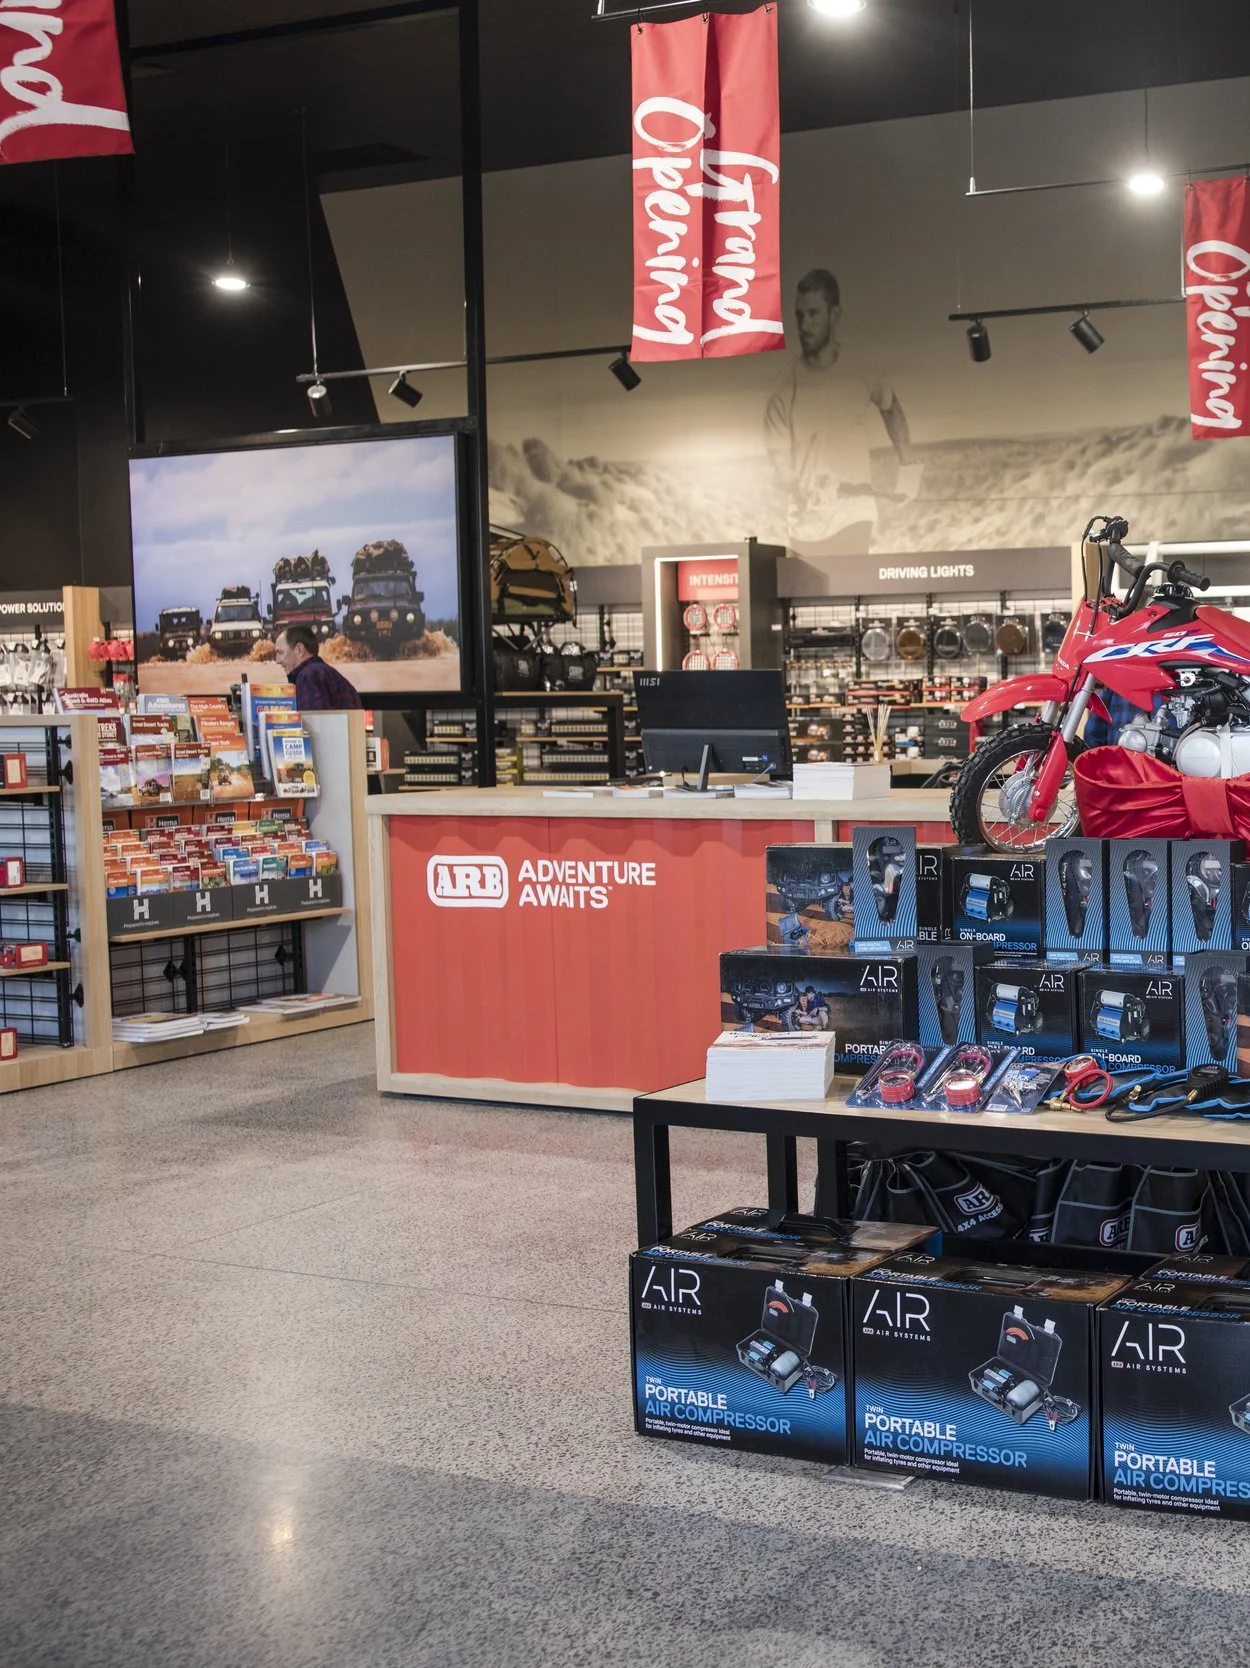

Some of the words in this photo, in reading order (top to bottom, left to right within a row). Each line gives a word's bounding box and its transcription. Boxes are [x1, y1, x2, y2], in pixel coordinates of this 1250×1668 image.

[632, 96, 716, 345] Opening
[685, 148, 784, 345] Grand
[879, 566, 928, 580] DRIVING
[930, 564, 975, 578] LIGHTS
[689, 573, 739, 587] INTENSIT
[27, 602, 65, 613] SOLUTIO
[148, 702, 186, 710] Adventures
[98, 722, 117, 731] TREKS
[158, 819, 178, 827] Hema
[517, 859, 656, 886] ADVENTURE
[917, 855, 938, 876] IR
[1010, 863, 1035, 878] AIR
[436, 864, 503, 898] ARB
[896, 939, 914, 949] AIR
[959, 932, 1006, 942] ON-BOARD
[993, 941, 1037, 951] PRESSOR
[860, 965, 898, 988] AIR
[1039, 974, 1065, 989] AIR
[1145, 980, 1173, 996] AIR
[1092, 1052, 1142, 1064] N-BOARD
[705, 1221, 766, 1232] PORTABLE
[650, 1246, 714, 1258] PORTABLE
[871, 1269, 940, 1282] PORTABLE
[1157, 1269, 1230, 1281] PORTABLE
[641, 1265, 701, 1306] AIR
[653, 1304, 665, 1312] AIR
[669, 1305, 702, 1316] SYSTEMS
[862, 1289, 931, 1332] AIR
[1117, 1299, 1191, 1312] PORTABLE
[1137, 1305, 1241, 1320] COMPRESSOR
[876, 1329, 890, 1337] AIR
[894, 1331, 931, 1342] SYSTEMS
[1111, 1320, 1187, 1364] AIR
[1126, 1362, 1141, 1370] AIR
[1145, 1364, 1187, 1375] SYSTEMS
[645, 1375, 662, 1385] TWIN
[645, 1384, 728, 1410] PORTABLE
[866, 1404, 884, 1414] TWIN
[645, 1400, 670, 1418] AIR
[674, 1405, 792, 1435] COMPRESSOR
[865, 1413, 957, 1441] PORTABLE
[864, 1430, 893, 1448] AIR
[897, 1435, 1028, 1468] COMPRESSOR
[1115, 1442, 1135, 1451] TWIN
[864, 1448, 886, 1458] Portable,
[886, 1451, 915, 1461] twin-motor
[915, 1455, 945, 1466] compressor
[945, 1460, 959, 1468] ideal
[872, 1454, 893, 1465] inflating
[893, 1458, 907, 1467] tyres
[906, 1459, 917, 1467] and
[917, 1461, 931, 1469] other
[931, 1464, 960, 1474] equipment
[1114, 1451, 1216, 1479] PORTABLE
[1113, 1469, 1146, 1488] AIR
[1113, 1487, 1138, 1498] Portable,
[1138, 1490, 1170, 1500] twin-motor
[1170, 1495, 1204, 1505] compressor
[1122, 1494, 1146, 1504] inflating
[1146, 1497, 1161, 1507] tyres
[1161, 1498, 1173, 1506] and
[1173, 1500, 1189, 1509] other
[1189, 1502, 1221, 1512] equipment
